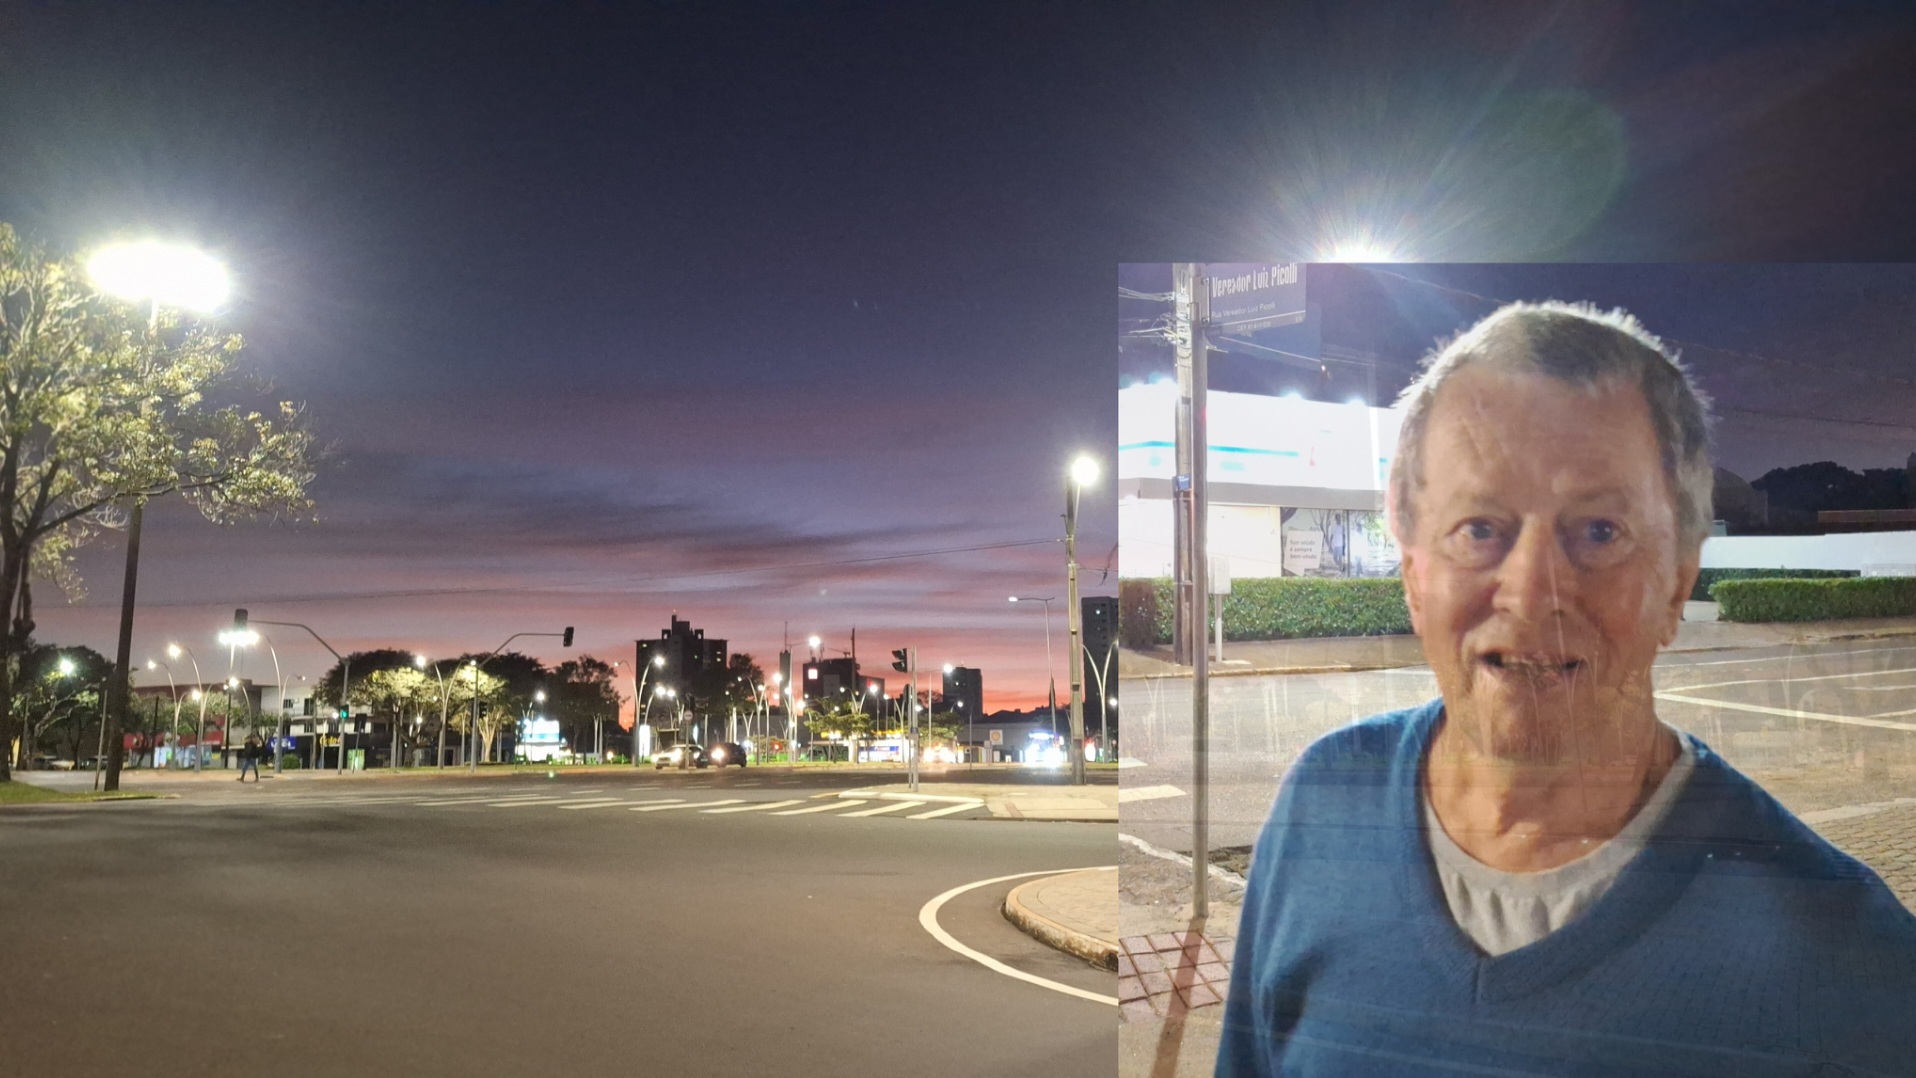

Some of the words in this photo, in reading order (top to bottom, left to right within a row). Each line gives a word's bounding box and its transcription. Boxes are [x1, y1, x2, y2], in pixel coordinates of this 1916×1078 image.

[1212, 274, 1251, 298] Vereador
[1253, 267, 1269, 291] Luiz
[1271, 263, 1298, 287] Picolli
